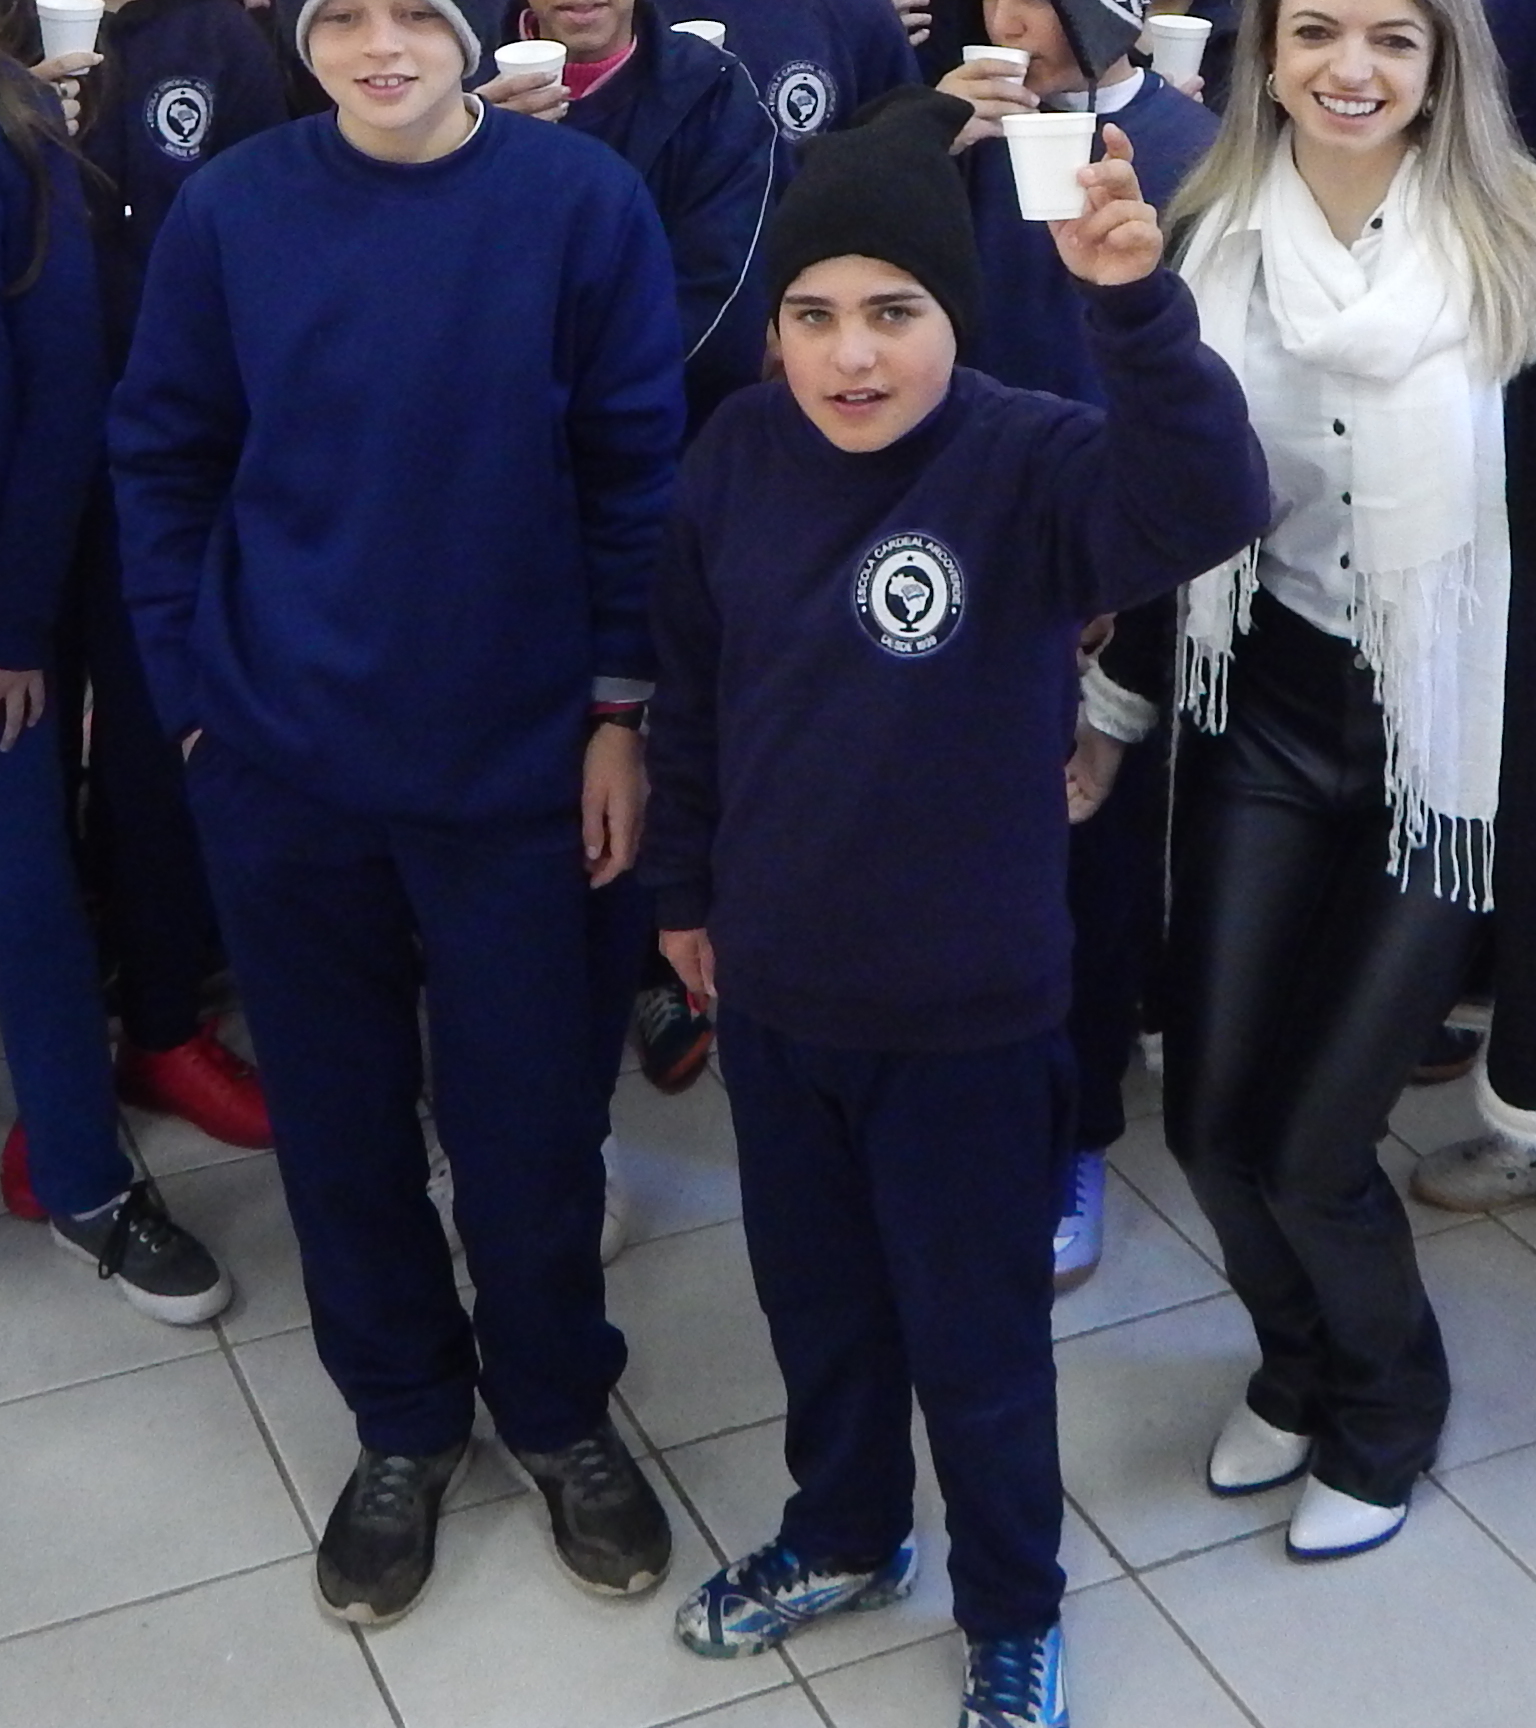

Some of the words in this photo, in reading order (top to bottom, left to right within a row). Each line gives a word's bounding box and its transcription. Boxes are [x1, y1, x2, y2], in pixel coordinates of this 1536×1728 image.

[857, 558, 877, 604] ESCOLA
[873, 535, 924, 559] CARDEAL
[925, 541, 962, 605] ARCOVERDE
